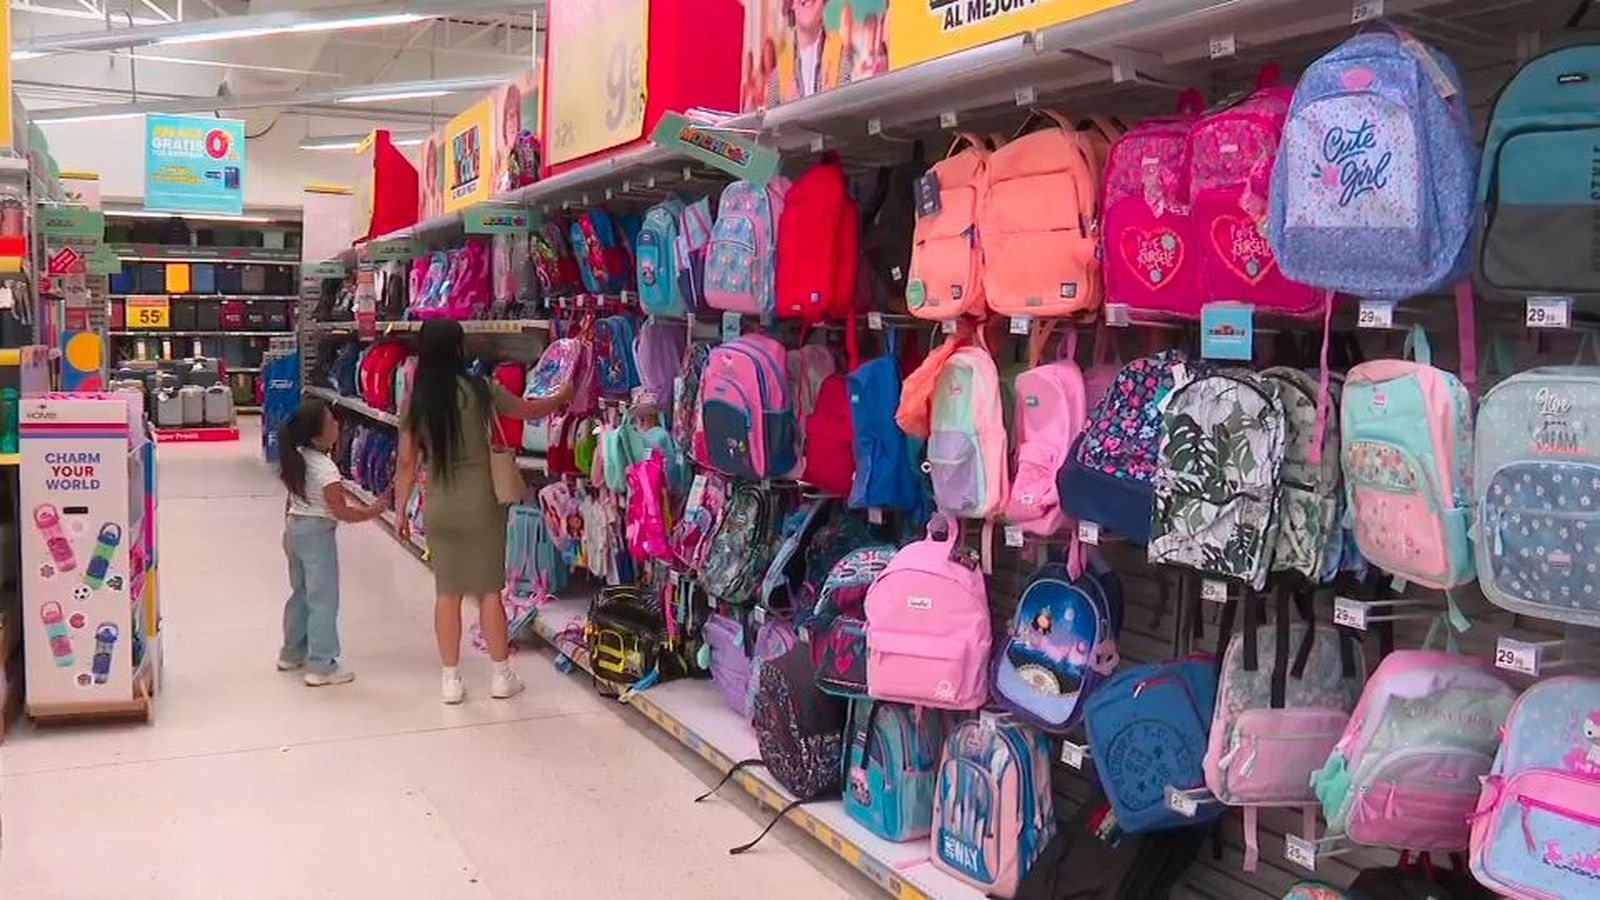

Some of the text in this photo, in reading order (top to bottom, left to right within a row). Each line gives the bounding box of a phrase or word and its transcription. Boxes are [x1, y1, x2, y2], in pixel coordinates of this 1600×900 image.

[944, 6, 963, 30] AL
[1323, 118, 1376, 162] Cute
[139, 309, 161, 323] 55
[1361, 310, 1374, 322] 29
[1528, 308, 1545, 321] 29
[44, 452, 101, 464] CHARM
[52, 466, 95, 478] YOUR
[46, 479, 100, 491] WORLD
[1498, 649, 1514, 664] 29
